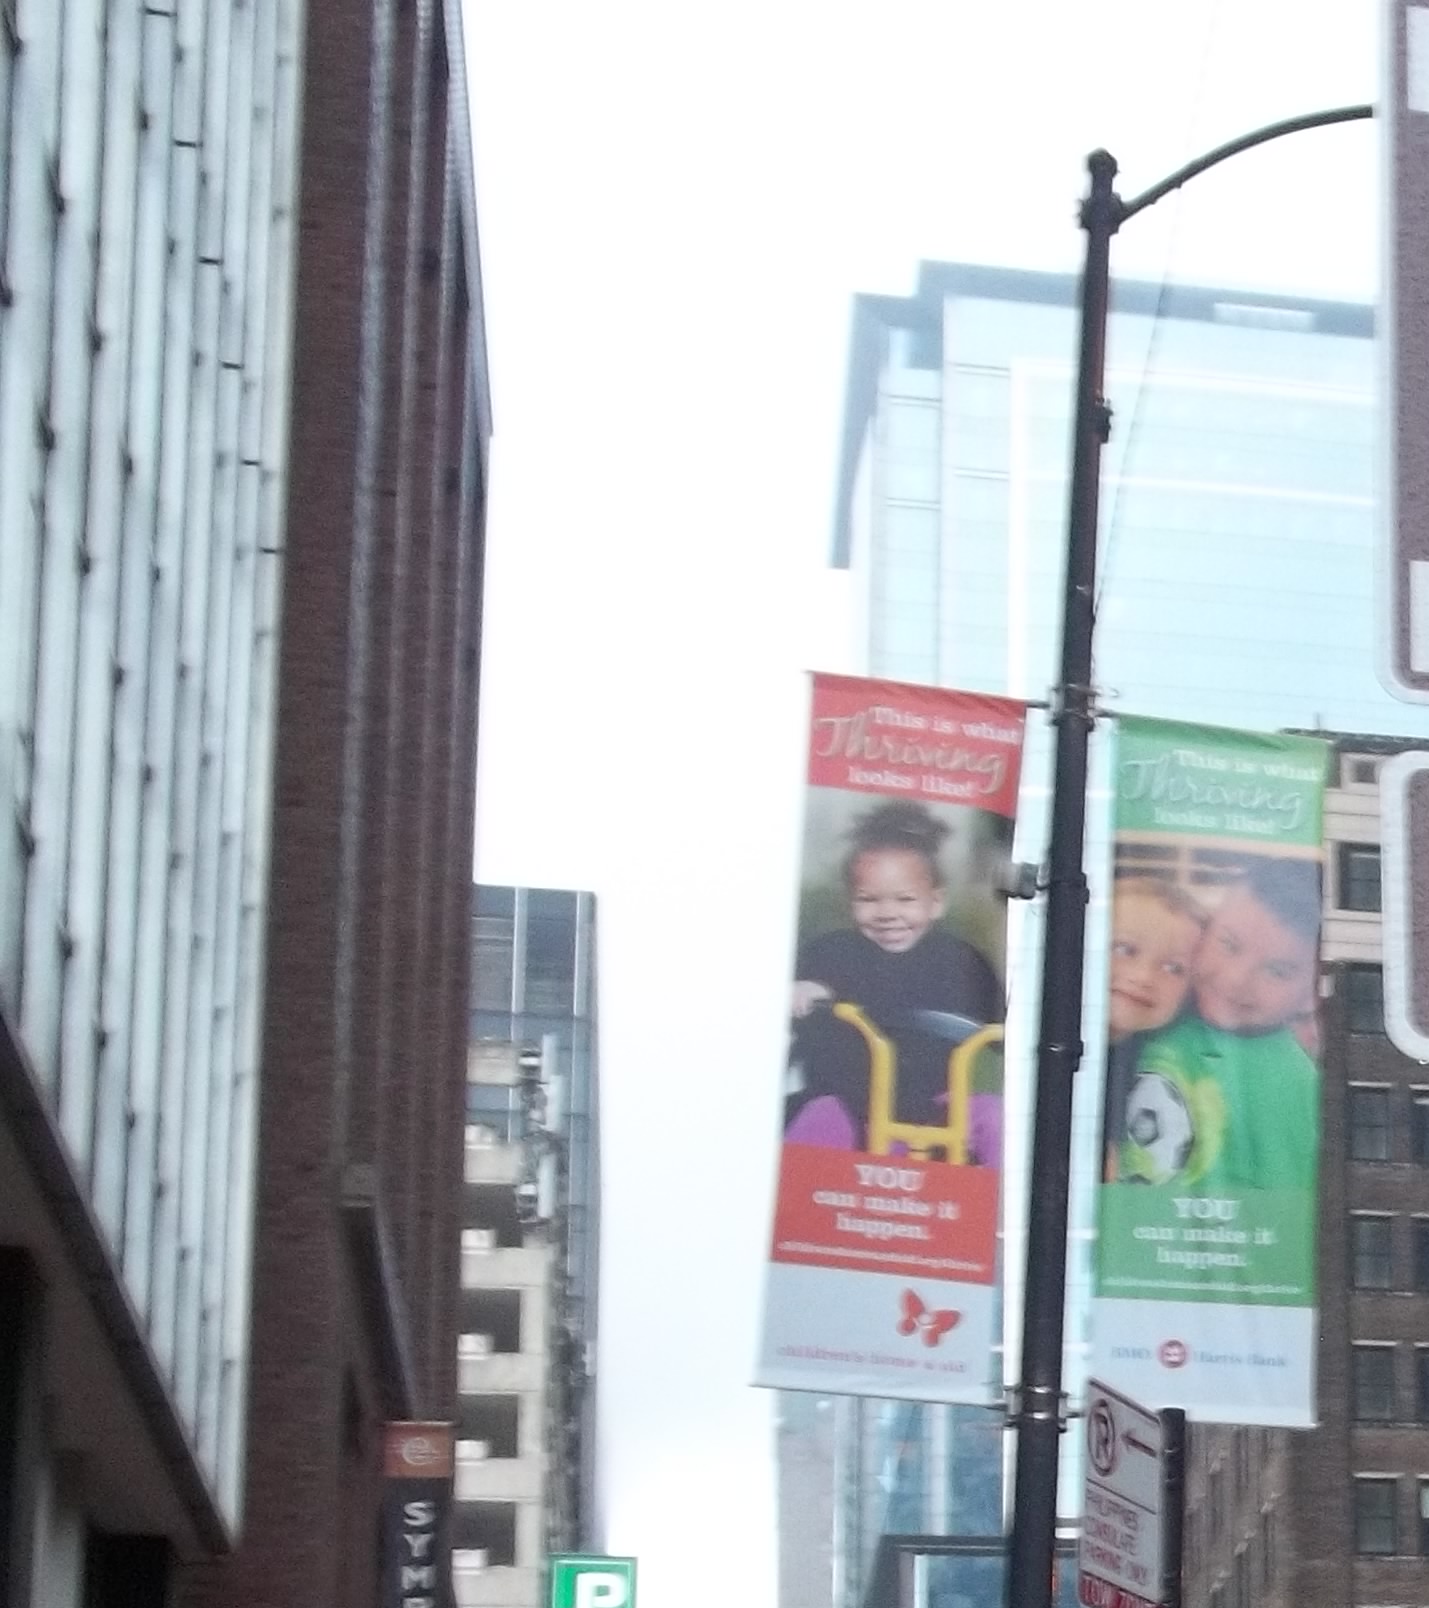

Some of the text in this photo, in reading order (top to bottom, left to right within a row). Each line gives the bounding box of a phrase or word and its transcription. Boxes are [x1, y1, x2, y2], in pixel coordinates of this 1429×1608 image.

[814, 711, 1006, 794] Thriving
[853, 1164, 926, 1192] YOU
[1173, 1197, 1241, 1221] YOU
[1081, 1574, 1113, 1608] TOW
